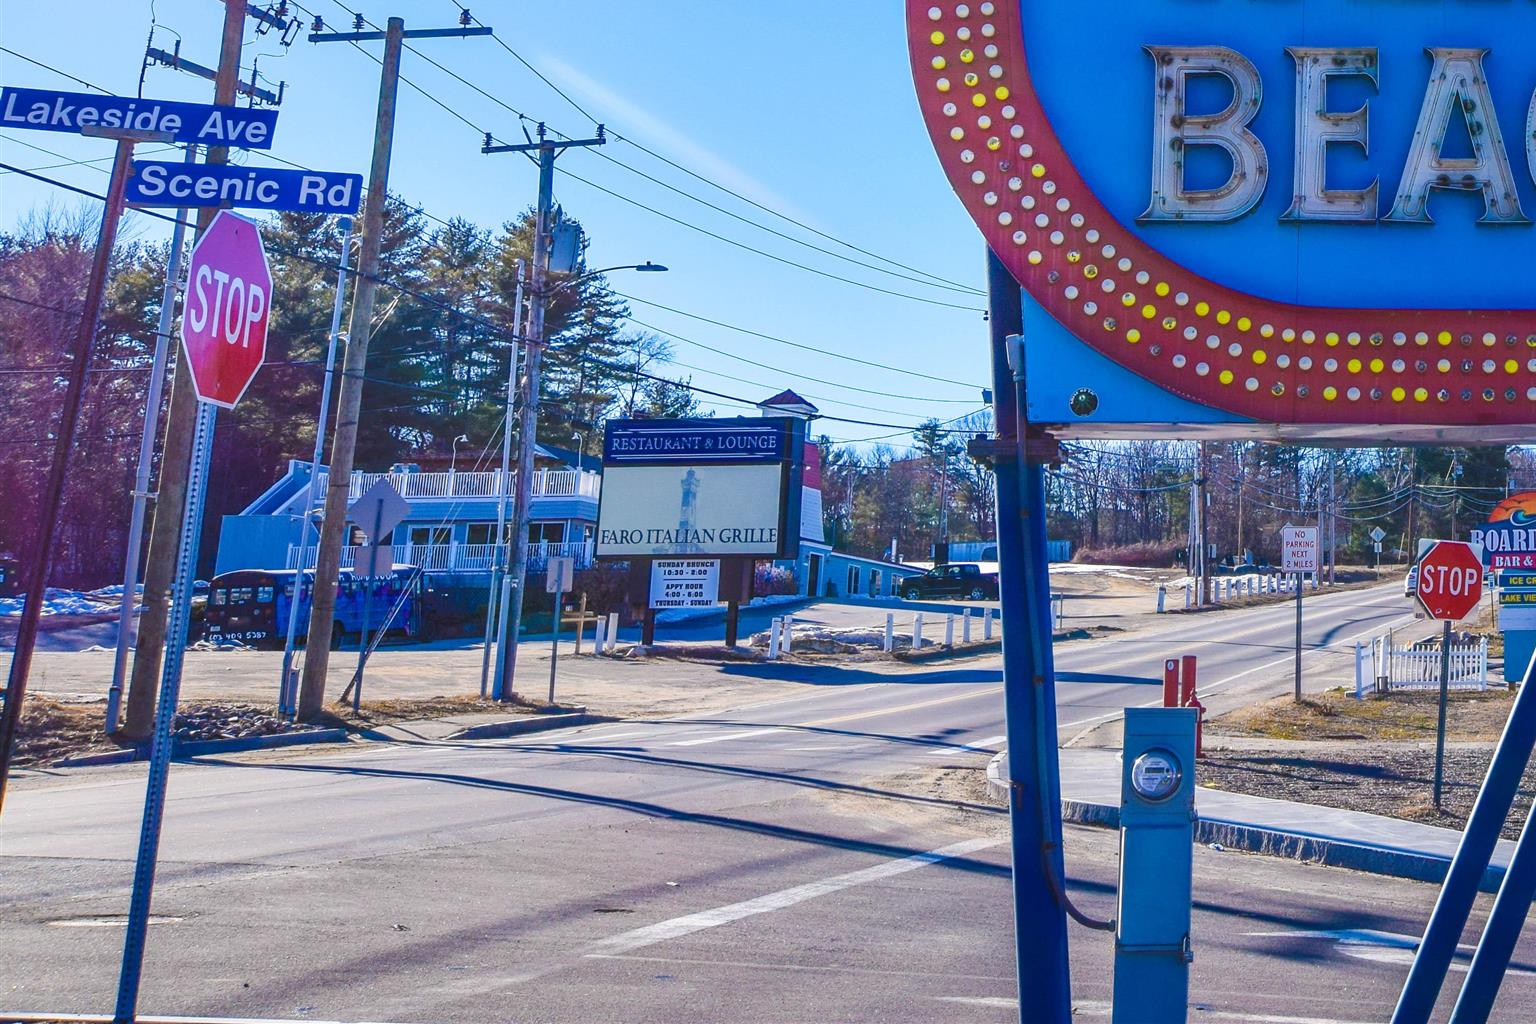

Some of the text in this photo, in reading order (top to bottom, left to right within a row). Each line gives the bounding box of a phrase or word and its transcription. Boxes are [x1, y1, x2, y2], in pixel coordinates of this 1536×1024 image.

[3, 92, 268, 144] Lakeside Ave
[137, 165, 353, 208] Scenic Rd
[190, 264, 265, 349] STOP
[611, 436, 702, 451] RESTAURANT
[717, 435, 777, 450] LOUNGE
[600, 527, 777, 545] FARO ITALIAN GRILLE
[1294, 530, 1306, 538] NO
[1285, 540, 1314, 548] PARKING
[1293, 560, 1313, 568] MILES
[1495, 555, 1520, 567] BAR
[1523, 555, 1533, 566] &
[1421, 564, 1478, 596] STOP
[1509, 576, 1524, 585] ICE
[1500, 594, 1521, 602] LAKE
